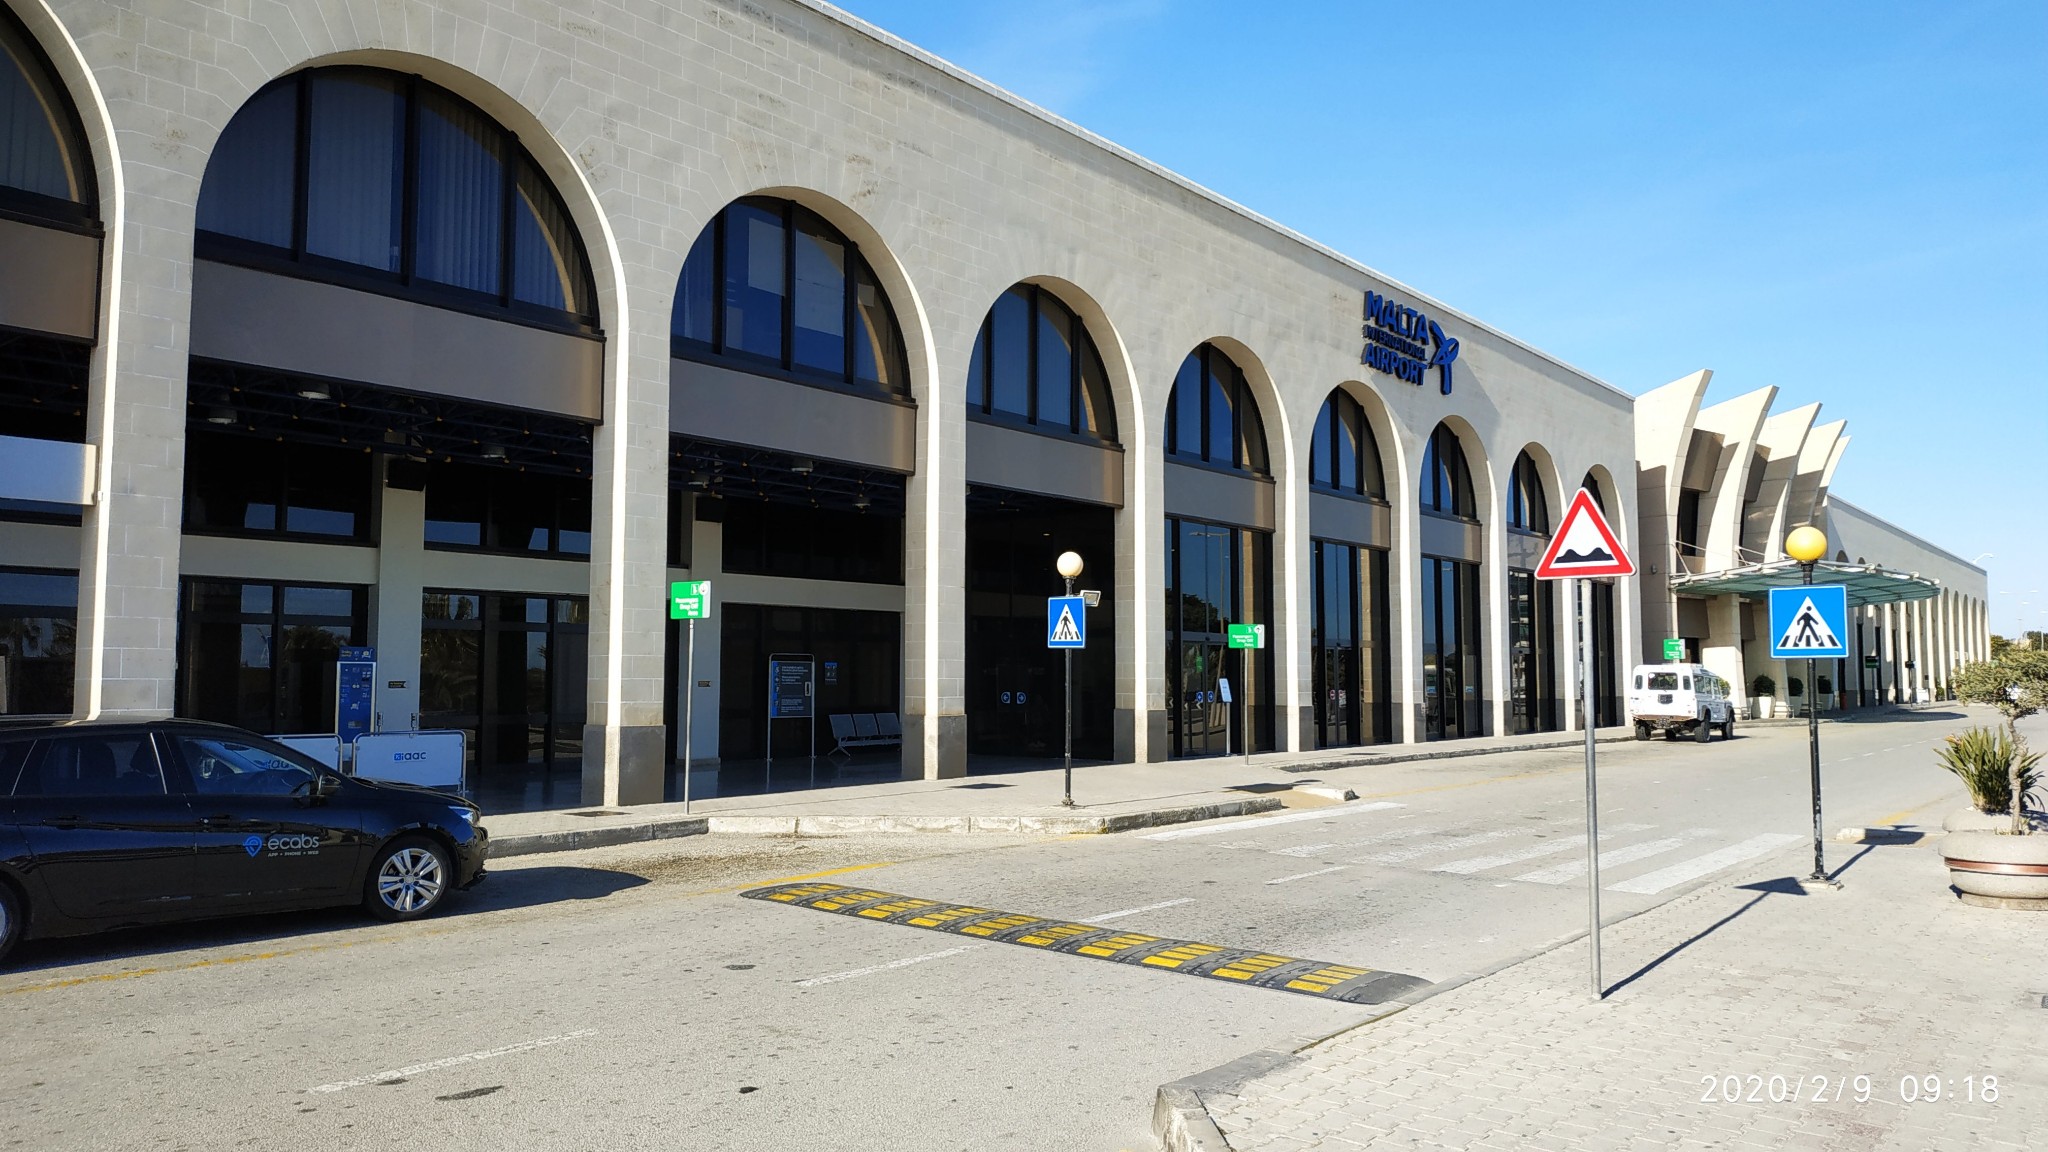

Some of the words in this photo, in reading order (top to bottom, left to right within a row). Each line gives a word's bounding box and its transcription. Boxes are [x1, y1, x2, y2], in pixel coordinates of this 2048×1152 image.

[1364, 290, 1429, 345] MALTA
[1362, 324, 1427, 361] INTERNATIONAL
[1361, 343, 1428, 386] AIRPORT
[267, 833, 320, 850] ecabs
